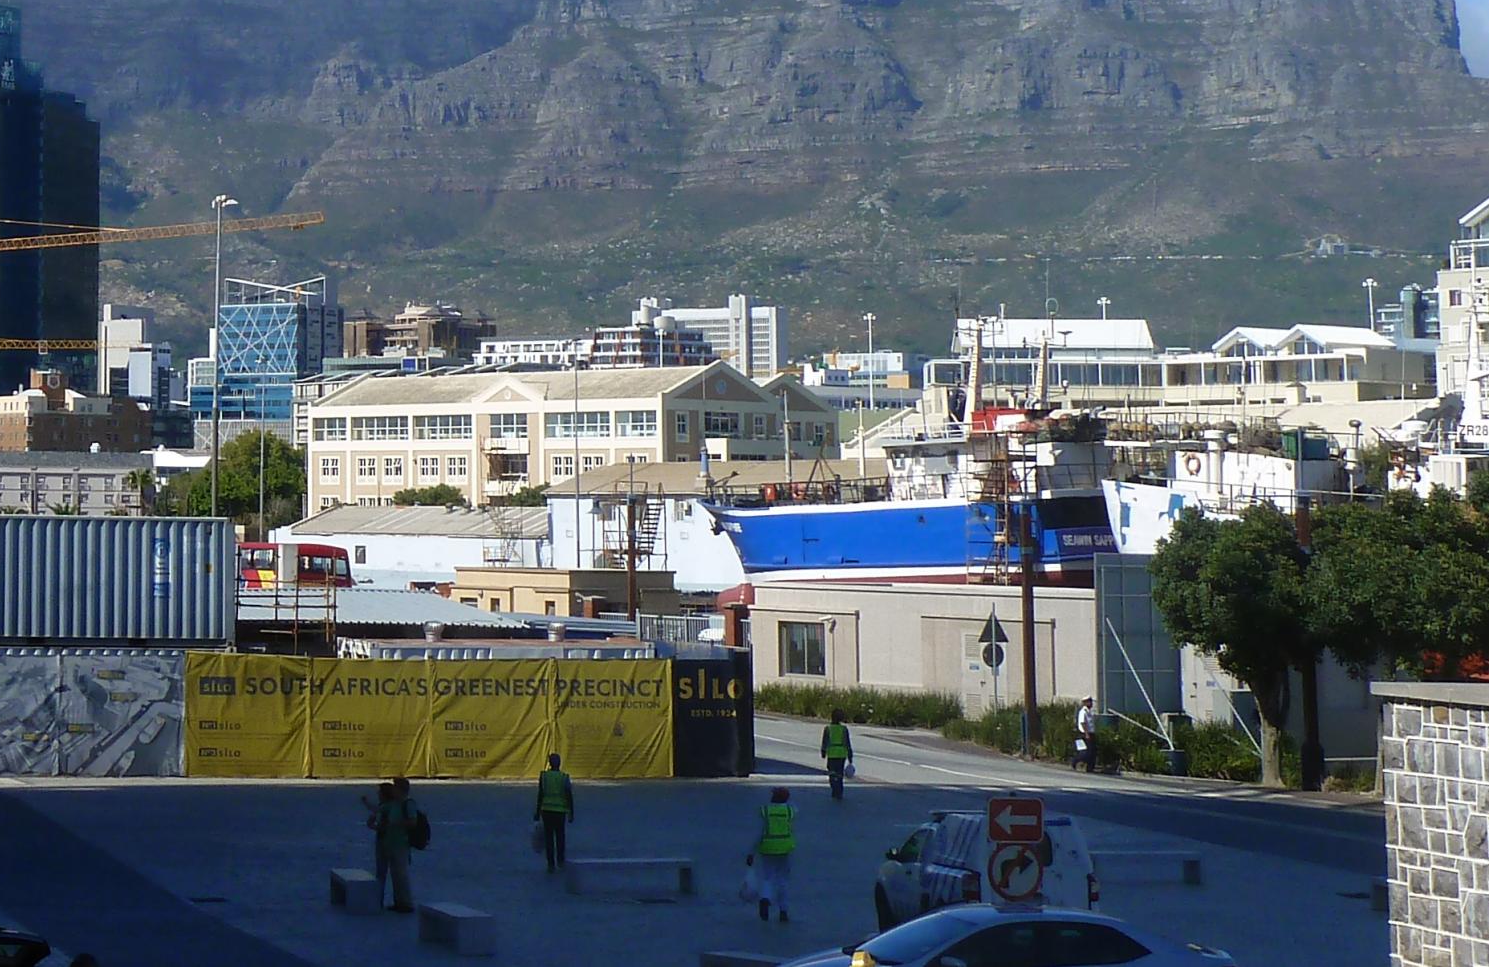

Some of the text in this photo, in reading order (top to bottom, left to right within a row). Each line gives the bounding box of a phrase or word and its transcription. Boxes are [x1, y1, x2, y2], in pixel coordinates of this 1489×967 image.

[246, 677, 323, 696] SOUTH
[331, 678, 428, 696] AFRICA'S
[436, 678, 547, 697] GREENEST
[555, 678, 663, 697] PRECINCT
[679, 668, 745, 699] SILO
[589, 700, 661, 709] CONSTRUCTION
